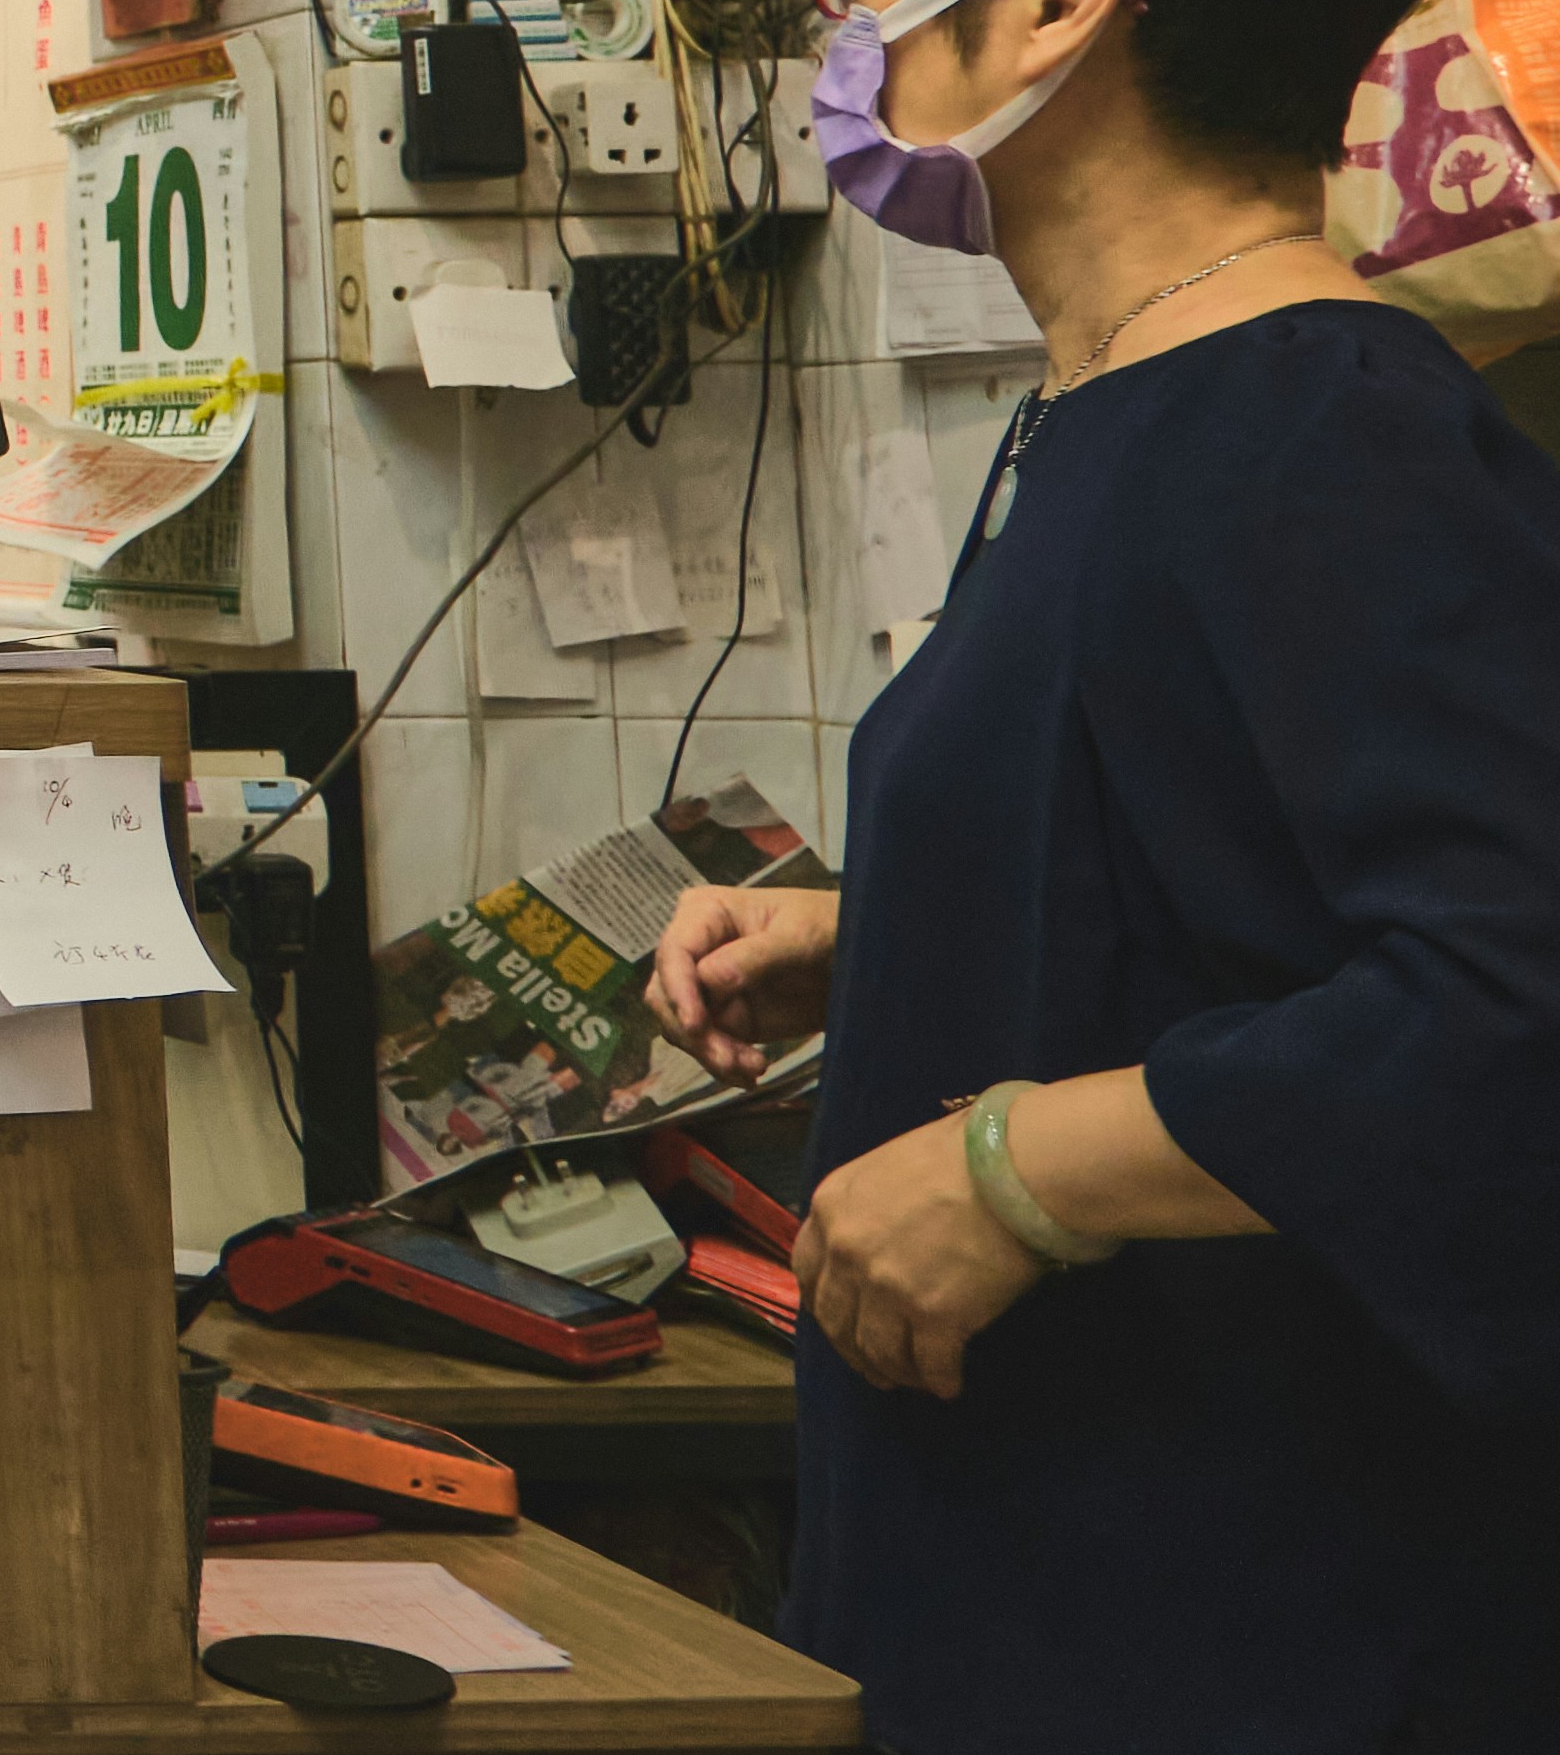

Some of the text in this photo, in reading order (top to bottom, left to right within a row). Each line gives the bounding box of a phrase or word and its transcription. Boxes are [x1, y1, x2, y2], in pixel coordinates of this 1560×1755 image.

[135, 109, 175, 137] APRIL
[105, 146, 208, 353] 10
[495, 947, 612, 1052] Stella
